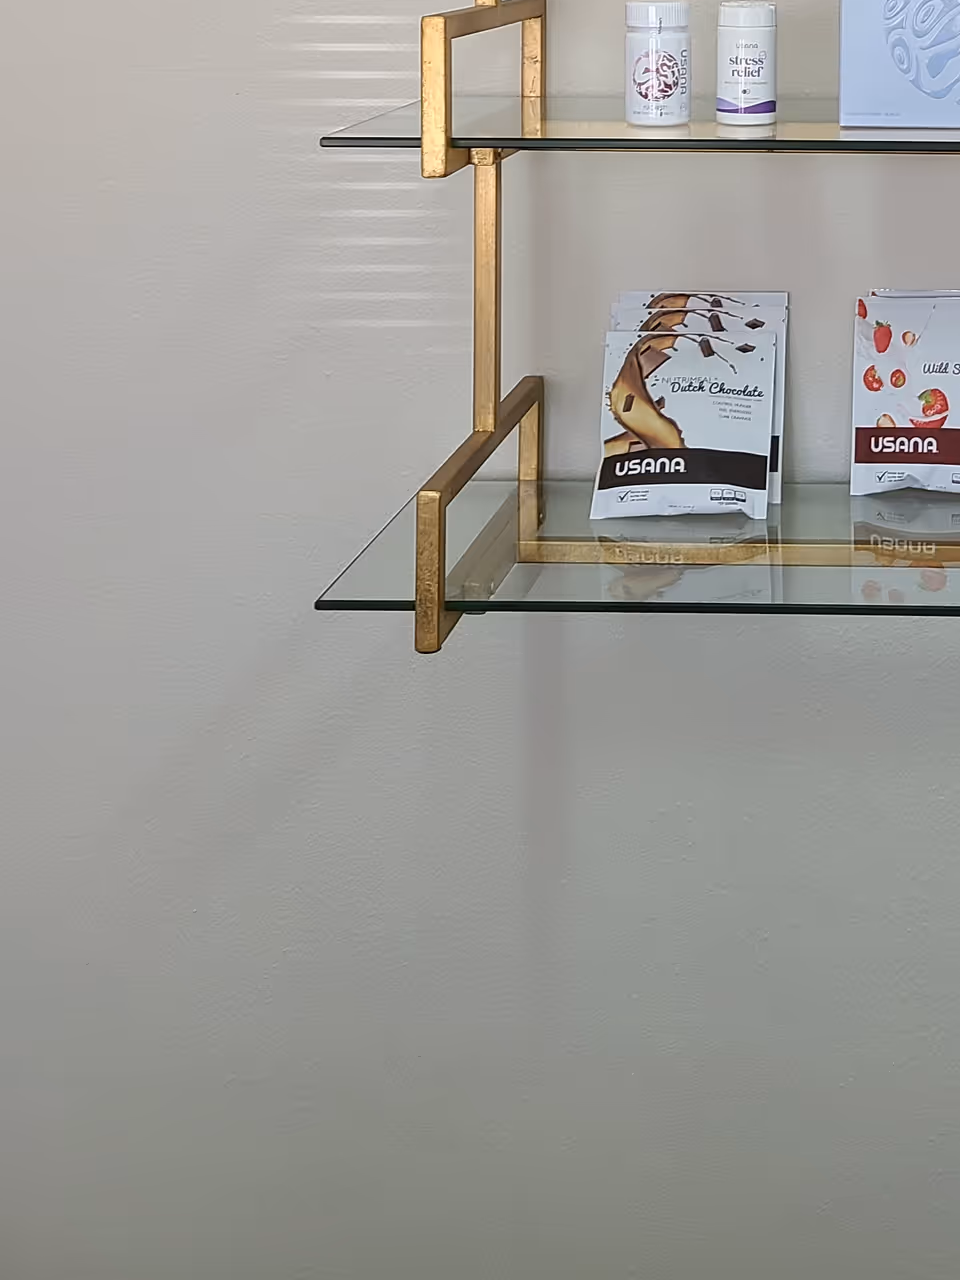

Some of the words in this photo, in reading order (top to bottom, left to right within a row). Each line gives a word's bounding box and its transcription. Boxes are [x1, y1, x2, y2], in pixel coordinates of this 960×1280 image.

[729, 55, 764, 66] stress
[680, 49, 689, 95] USANA
[731, 66, 764, 78] relief
[922, 361, 950, 374] Wild
[670, 380, 706, 393] Dutch
[708, 382, 764, 398] Chocolate
[870, 436, 937, 454] USANA
[614, 456, 686, 477] USANA
